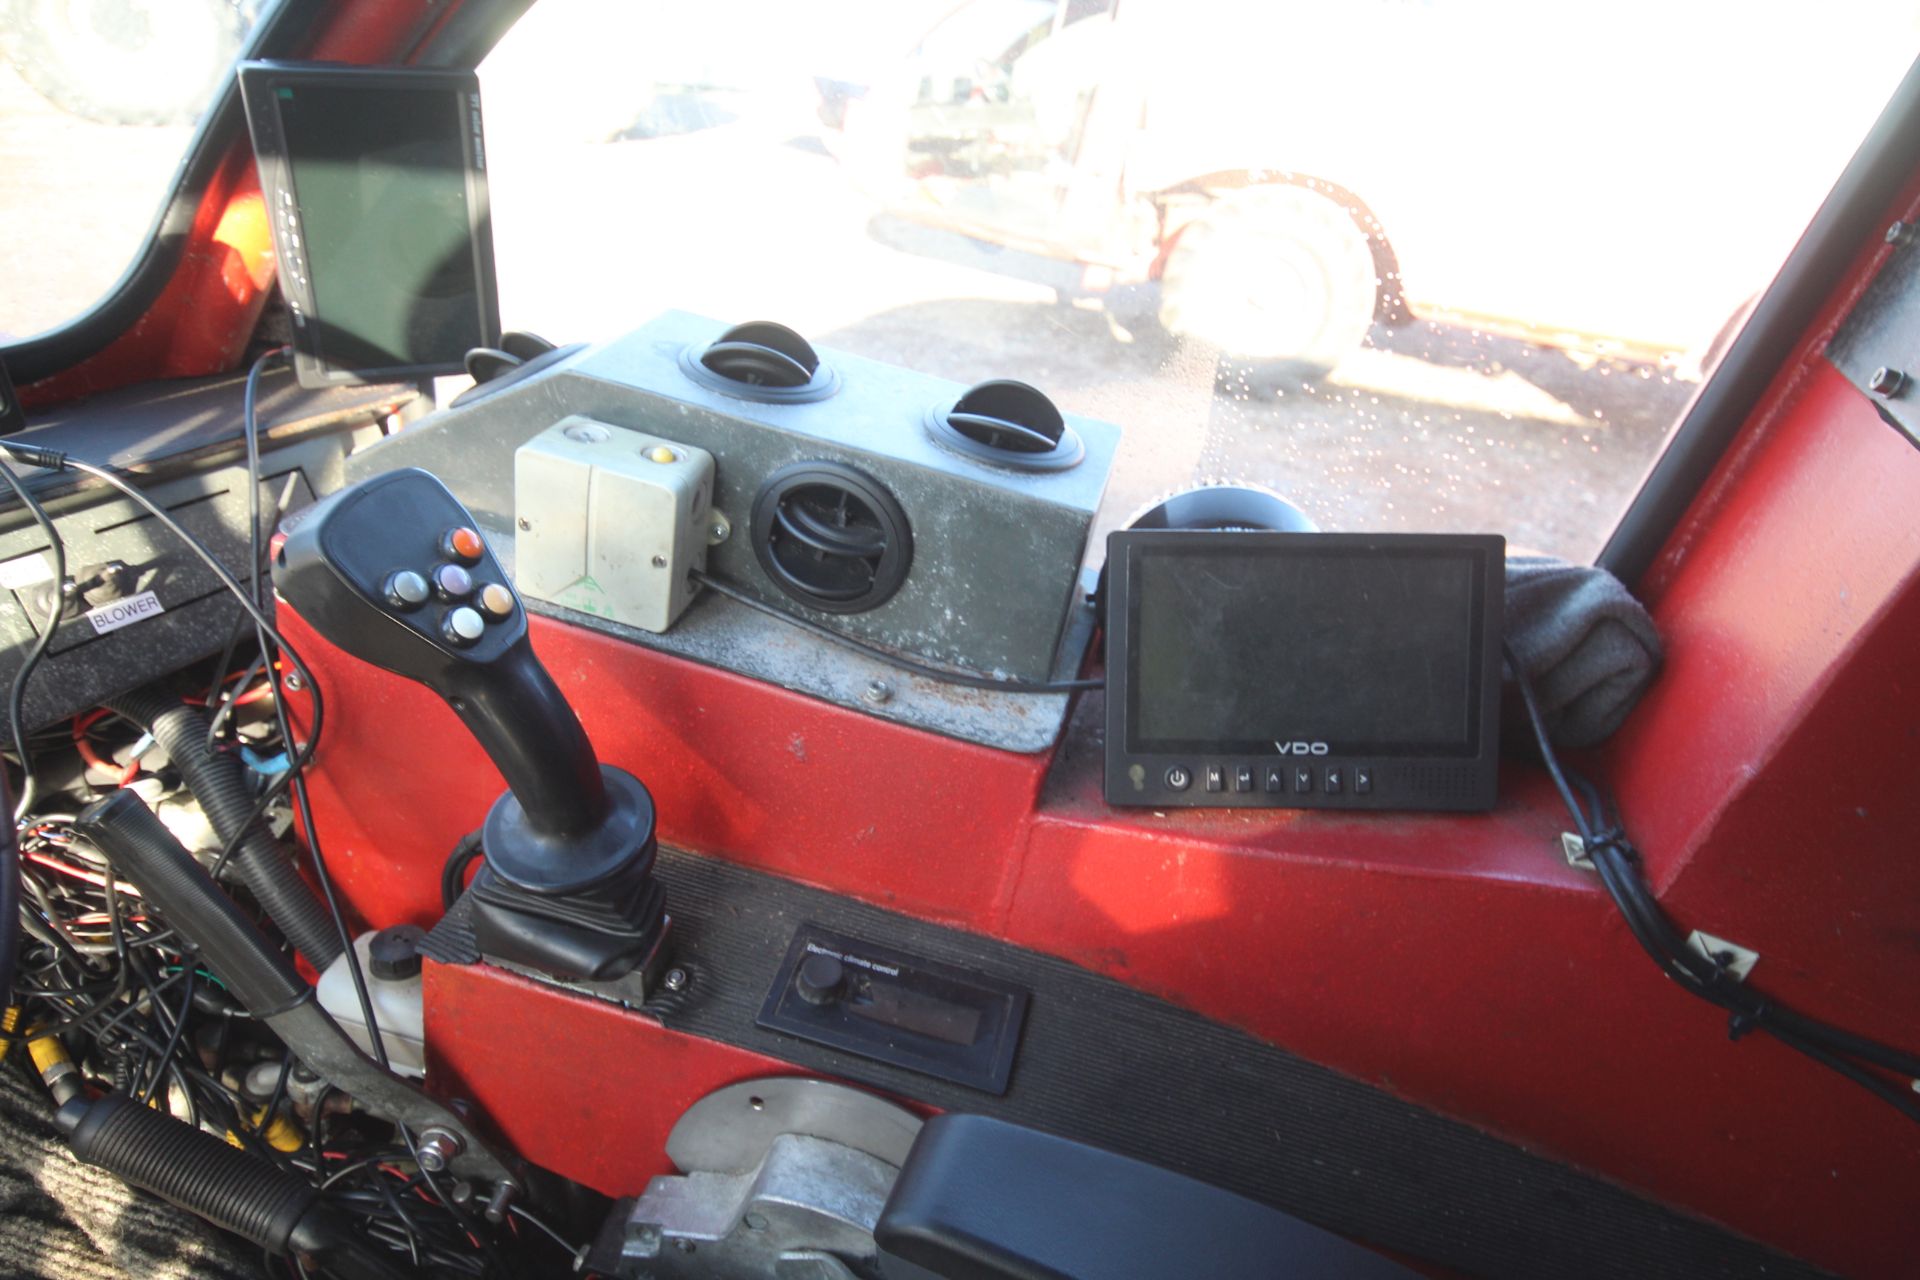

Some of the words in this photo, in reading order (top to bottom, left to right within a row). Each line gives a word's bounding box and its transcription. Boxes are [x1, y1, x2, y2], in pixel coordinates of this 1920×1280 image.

[93, 596, 159, 628] BLOWER
[1275, 741, 1329, 756] VDO
[1210, 771, 1219, 783] M
[806, 942, 843, 960] Electronic
[843, 954, 870, 969] climate
[871, 963, 899, 977] control
